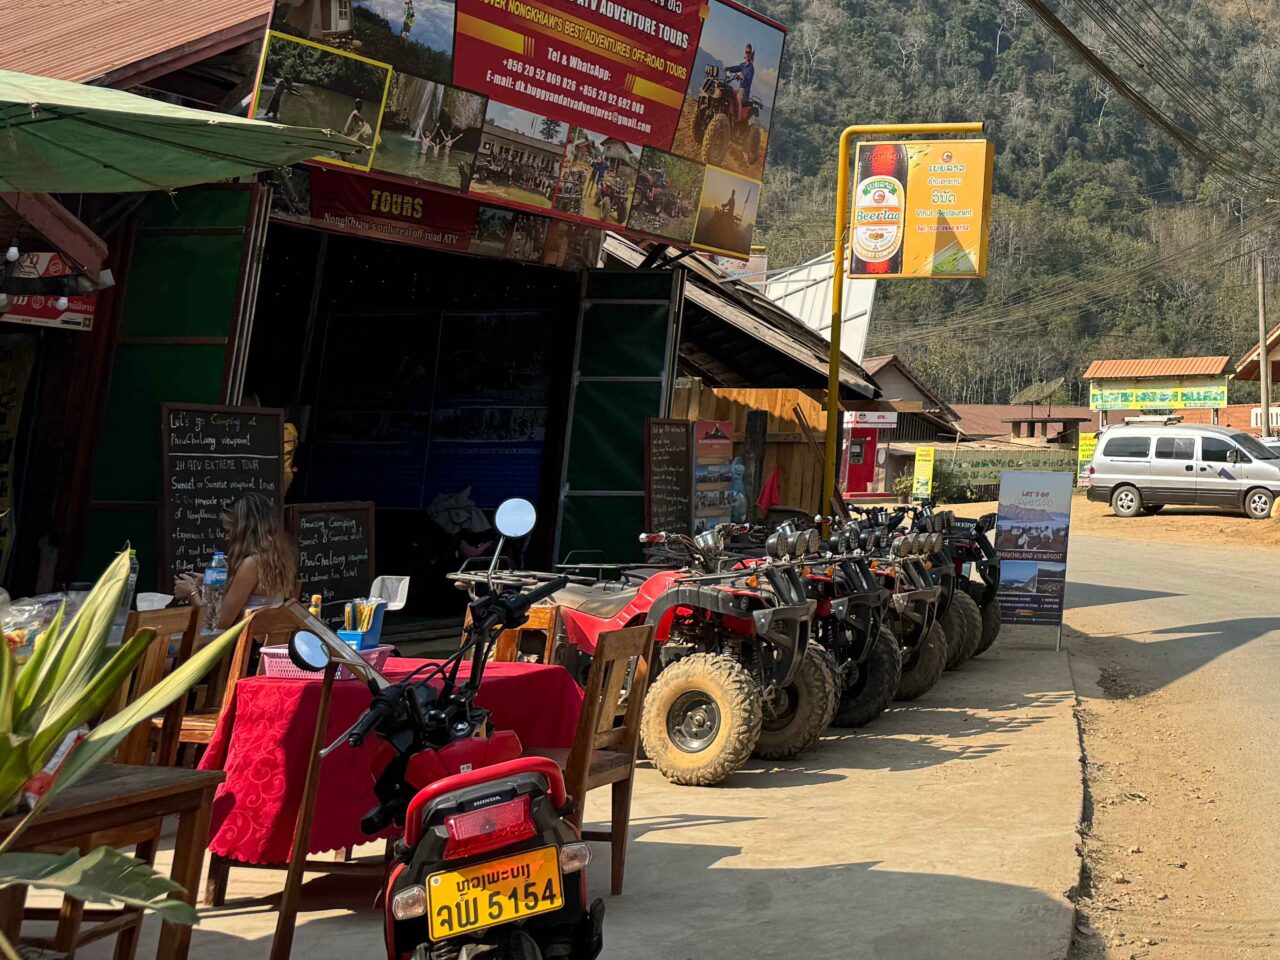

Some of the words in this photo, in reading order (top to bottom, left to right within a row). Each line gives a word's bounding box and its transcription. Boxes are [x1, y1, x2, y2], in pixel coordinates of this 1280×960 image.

[600, 0, 656, 36] ADVENTURE
[658, 23, 689, 49] TOURS
[507, 0, 563, 32] NONGKHIAW'S
[564, 21, 584, 41] BEST
[584, 30, 631, 59] ADVENTURES
[632, 47, 664, 71] OFF-ROAD
[665, 60, 687, 80] TOURS
[547, 48, 560, 62] Tel
[562, 54, 568, 66] &
[569, 55, 612, 82] WhatsApp:
[502, 58, 523, 73] +856
[524, 63, 535, 77] 20
[535, 67, 546, 81] 52
[547, 70, 562, 86] 869
[562, 75, 577, 91] 826
[579, 81, 598, 99] +856
[598, 87, 608, 102] 20
[608, 91, 619, 106] 92
[486, 70, 514, 90] E-mail:
[515, 77, 651, 134] dk.buggyandatvadventures@gmail.com
[371, 189, 423, 219] TOURS
[857, 209, 900, 222] Beerlao
[937, 209, 972, 217] Restaurant
[323, 212, 376, 231] NongKhiaw's
[378, 223, 395, 236] only
[396, 225, 411, 237] real
[412, 230, 442, 242] off-road
[443, 235, 458, 244] ATV
[170, 410, 189, 428] Let's
[195, 417, 206, 432] go
[221, 433, 251, 448] viewpoint
[187, 460, 202, 471] ATV
[204, 460, 236, 471] EXTREME
[242, 460, 259, 471] TOUR
[171, 476, 195, 490] Sunset
[204, 476, 227, 489] Sunrise
[300, 518, 325, 531] Amazing
[329, 517, 356, 533] Camping
[474, 795, 501, 807] HONDA
[488, 878, 556, 920] 5154
